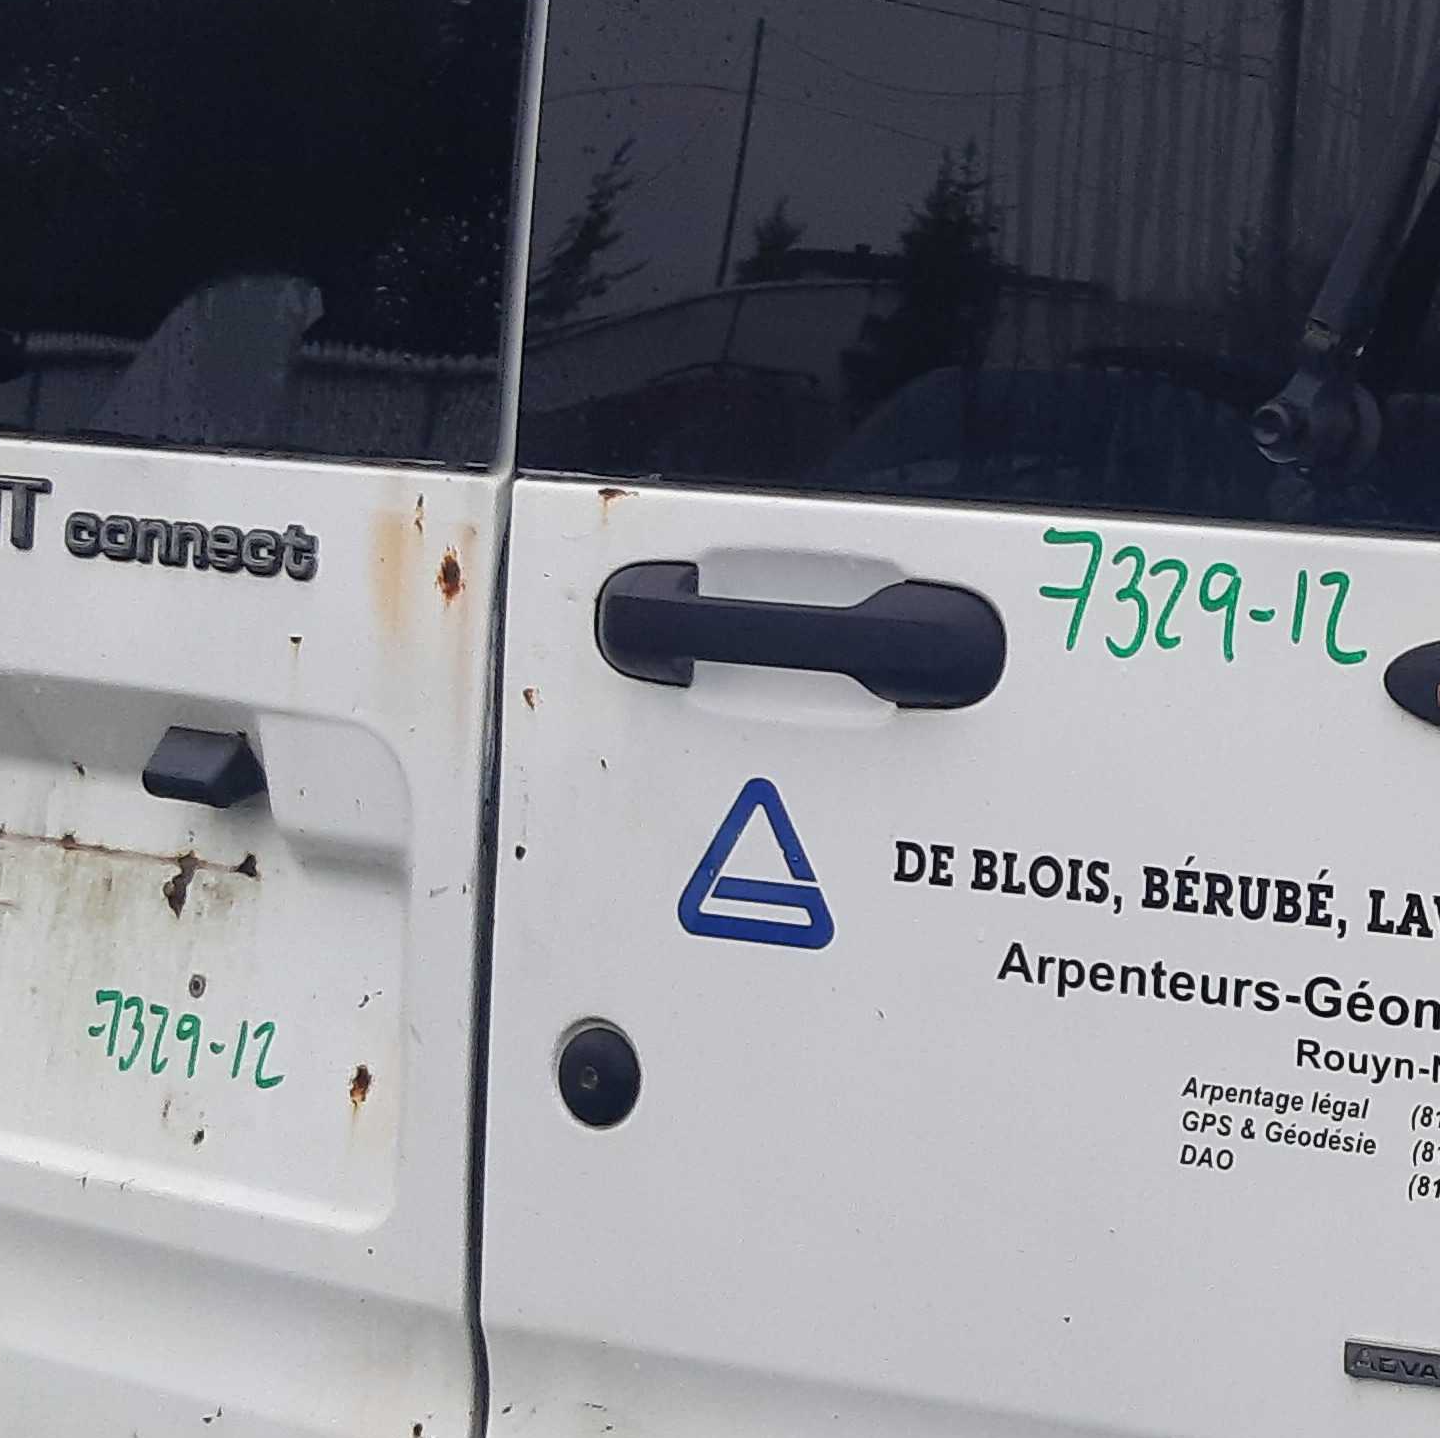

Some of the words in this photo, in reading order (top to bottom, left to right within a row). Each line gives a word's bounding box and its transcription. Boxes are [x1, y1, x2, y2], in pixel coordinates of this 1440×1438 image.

[64, 511, 318, 580] connect
[1038, 527, 1368, 664] 7329-12
[893, 841, 955, 888] DE
[971, 848, 1124, 913] BLOIS,
[1141, 855, 1349, 938] BÉRUBÉ,
[88, 988, 287, 1090] 7329-12
[1181, 1076, 1304, 1114] Arpentage
[1311, 1091, 1370, 1122] légal
[1182, 1110, 1233, 1137] GPS
[1240, 1118, 1257, 1140] &
[1265, 1121, 1378, 1156] Géodésie
[1179, 1144, 1235, 1171] DAO
